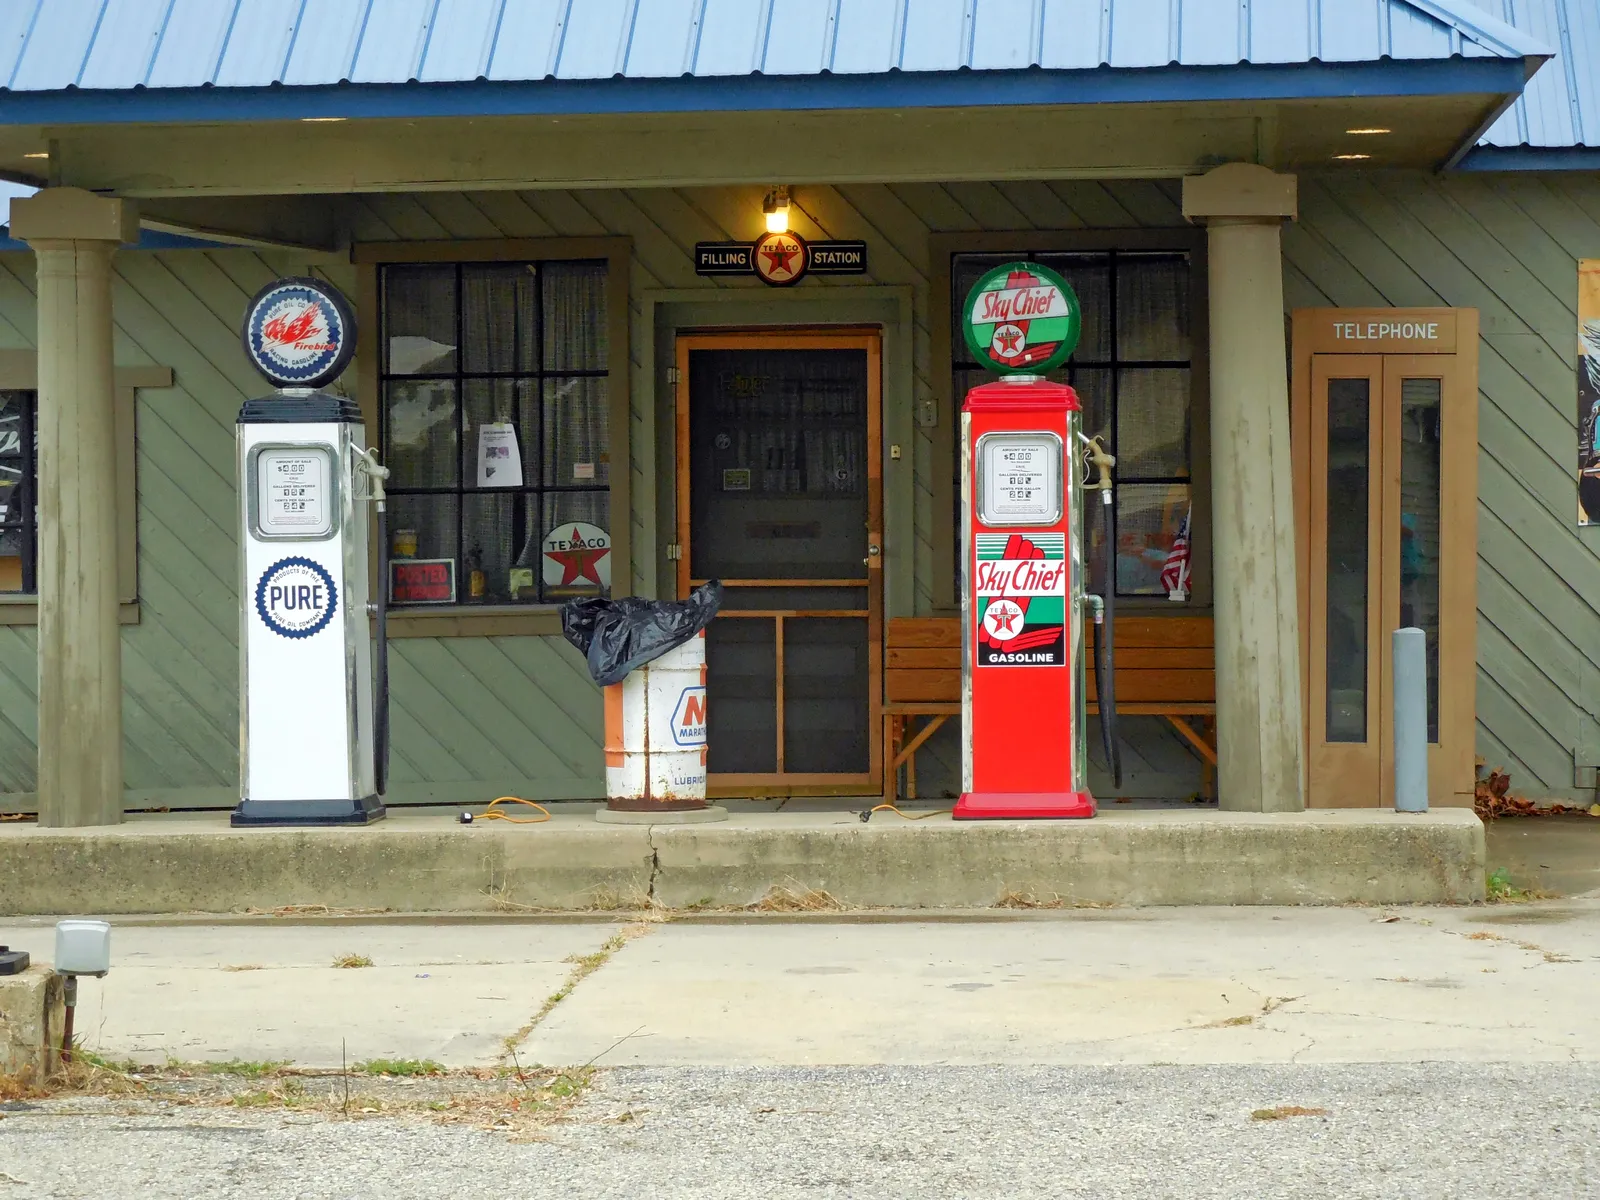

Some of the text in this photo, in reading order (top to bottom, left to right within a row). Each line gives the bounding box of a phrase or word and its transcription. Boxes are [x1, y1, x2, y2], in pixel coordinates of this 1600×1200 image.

[762, 244, 799, 252] TEXACO
[702, 252, 860, 265] FILLING STATION
[981, 287, 1055, 320] Sky Chief
[269, 304, 282, 319] PURE
[1333, 323, 1438, 339] TELEPHONE
[293, 341, 336, 351] Firebird
[269, 348, 318, 365] RACING GASOLINE
[549, 538, 605, 551] TEXACO
[273, 568, 300, 583] PRODUCTS
[310, 573, 320, 583] THE
[977, 560, 1064, 600] Sky Chief
[270, 585, 323, 611] PURE
[273, 612, 286, 624] PURE
[298, 611, 322, 627] COMPANY
[989, 653, 1053, 663] GASOLINE
[682, 695, 706, 726] M
